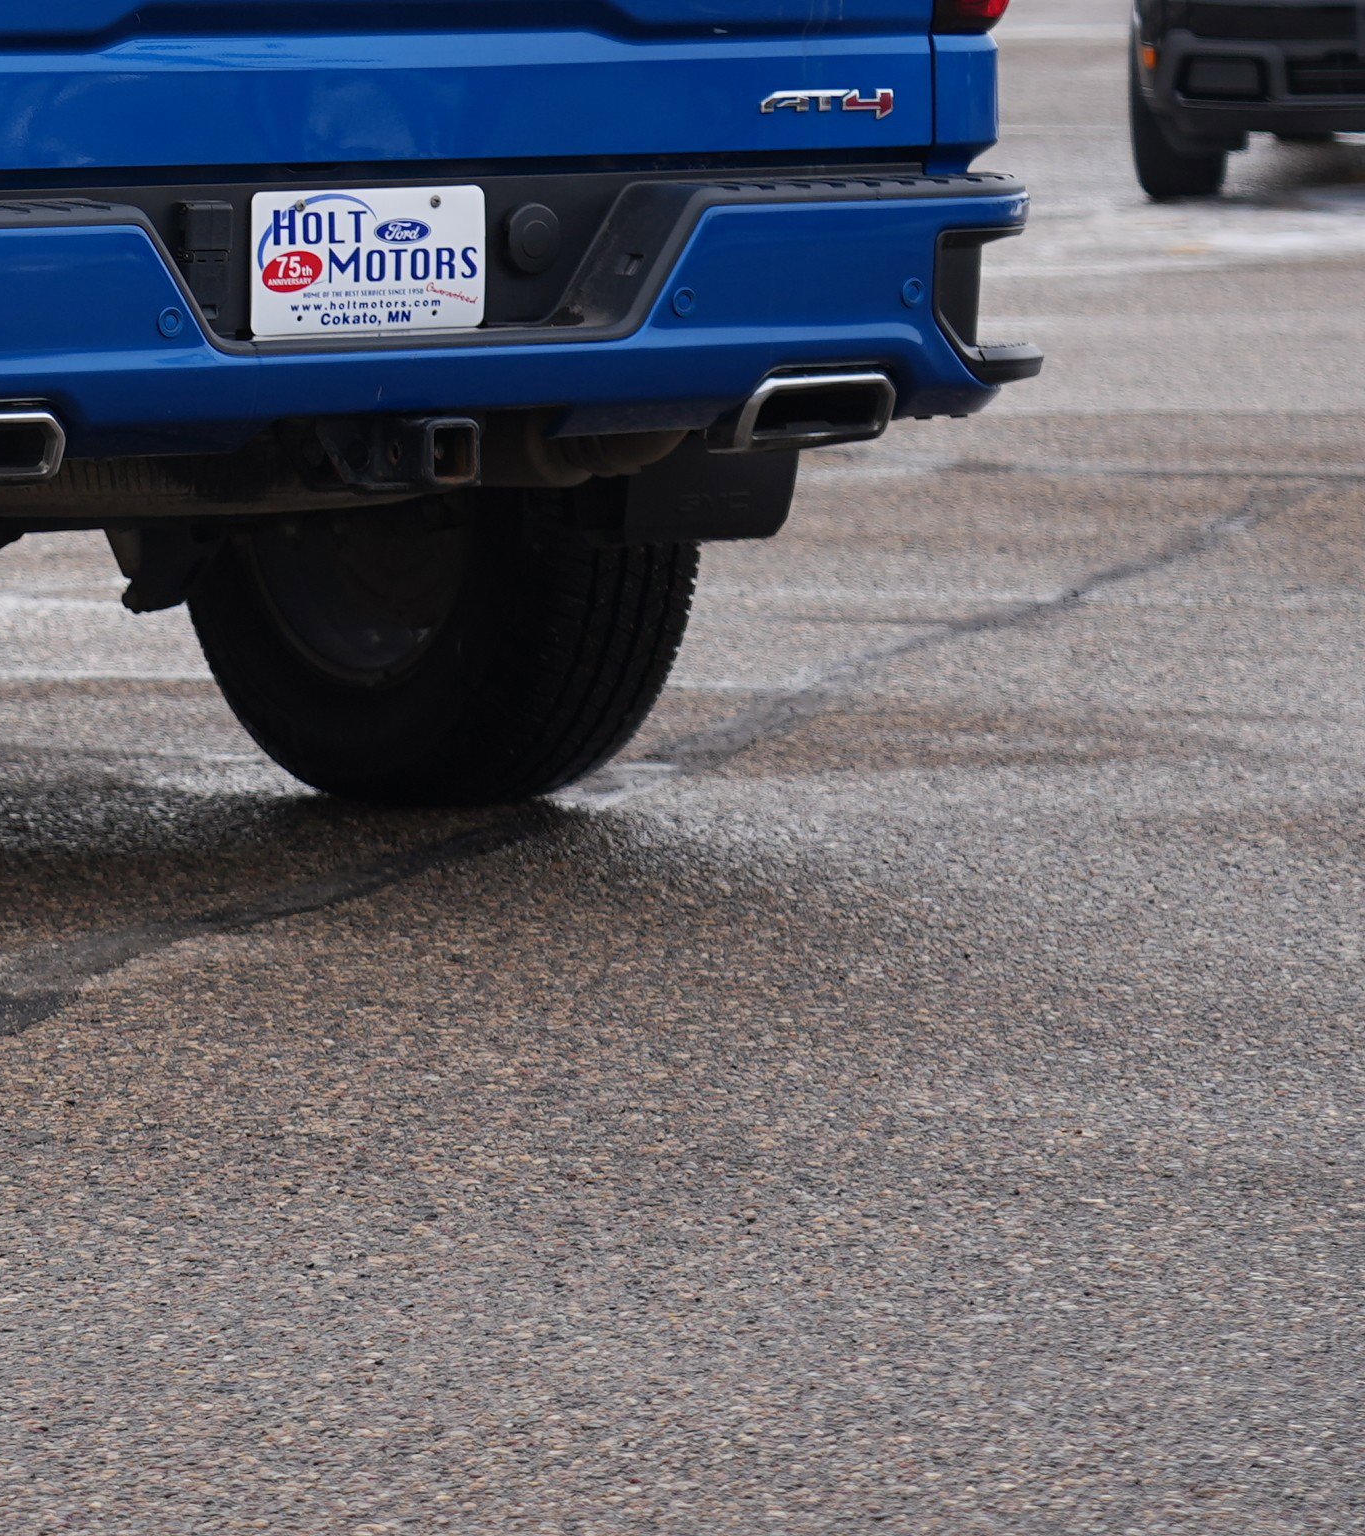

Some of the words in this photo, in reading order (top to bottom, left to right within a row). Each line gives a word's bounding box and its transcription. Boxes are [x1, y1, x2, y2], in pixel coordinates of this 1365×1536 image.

[760, 88, 894, 120] AT4
[273, 210, 367, 246] HOLT
[275, 255, 314, 279] 75th
[328, 247, 478, 284] MOTORS
[267, 277, 313, 287] ANNIVERSARY
[290, 299, 441, 311] www.holtmotors.com
[321, 312, 381, 326] Cokato,
[388, 310, 411, 323] MN
